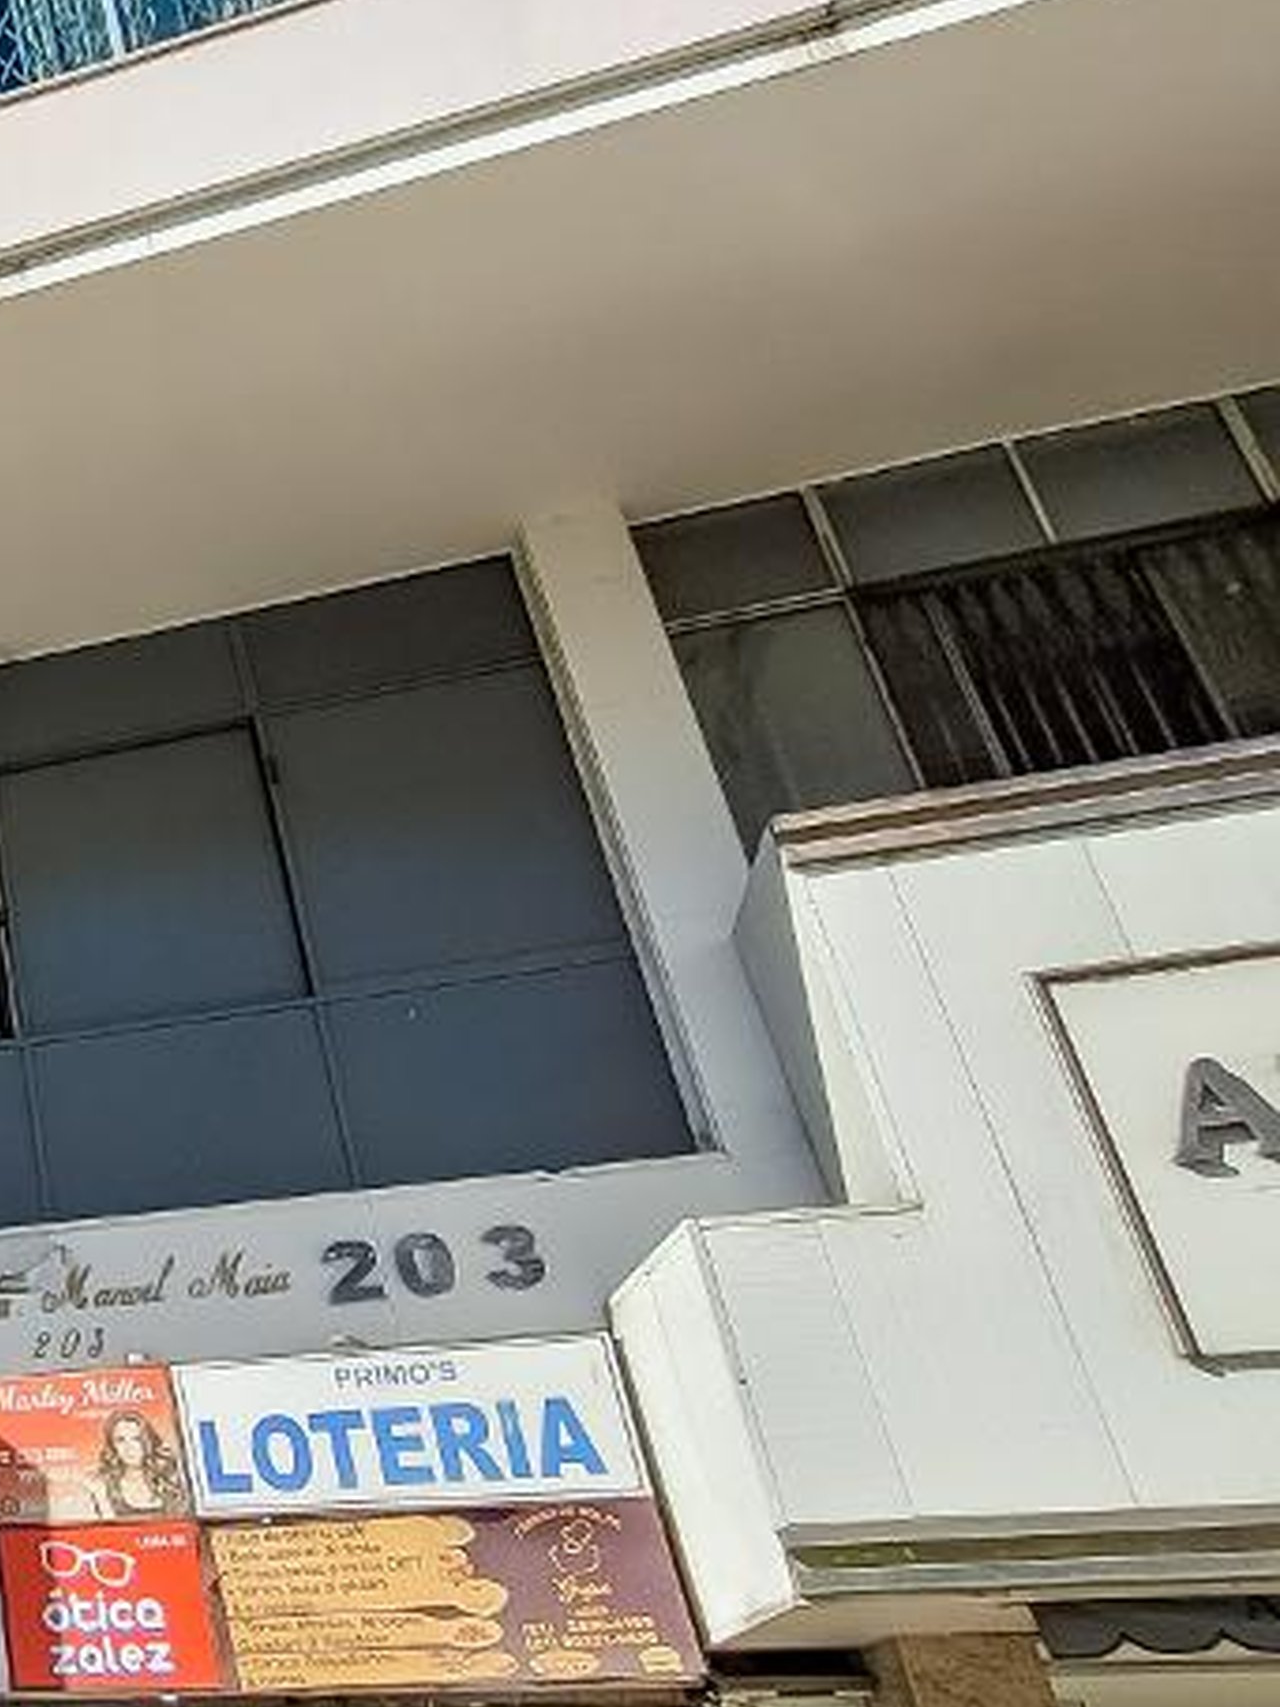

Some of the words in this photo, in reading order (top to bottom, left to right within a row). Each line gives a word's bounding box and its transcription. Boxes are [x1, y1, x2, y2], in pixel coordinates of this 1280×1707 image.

[188, 1245, 293, 1299] Maia
[320, 1224, 546, 1305] 203
[33, 1326, 105, 1360] 203
[333, 1360, 459, 1390] PRIMO'S
[199, 1395, 609, 1494] LOTERIA
[49, 1635, 177, 1676] zalez
